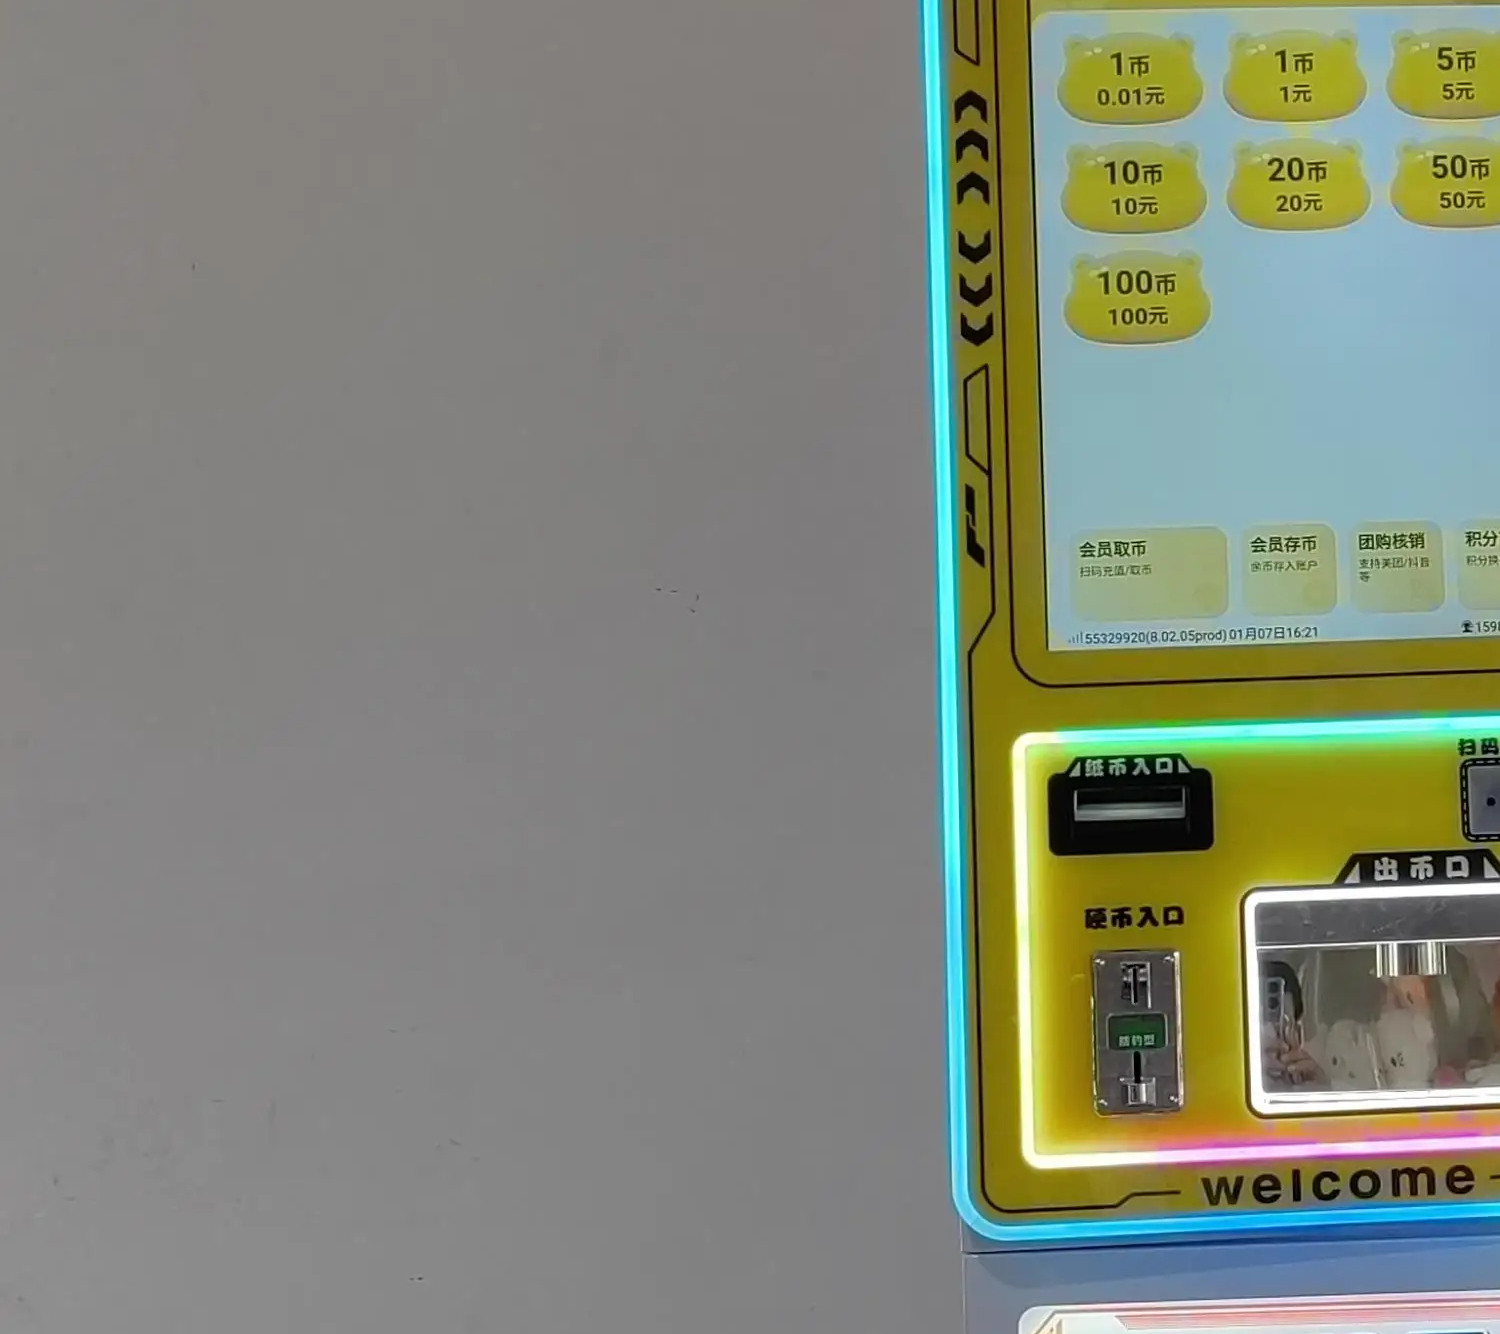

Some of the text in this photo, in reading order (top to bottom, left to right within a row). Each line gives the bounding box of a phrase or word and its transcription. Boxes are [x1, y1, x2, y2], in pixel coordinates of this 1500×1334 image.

[1109, 50, 1151, 79] 1币
[1274, 48, 1314, 76] 1币
[1436, 46, 1477, 74] 5币
[1096, 86, 1165, 108] 0.01元
[1279, 84, 1313, 105] 1元
[1441, 82, 1476, 102] 5元
[1103, 159, 1164, 187] 10币
[1267, 156, 1328, 185] 20币
[1431, 154, 1491, 182] 50币
[1111, 196, 1159, 217] 10元
[1275, 193, 1324, 214] 20元
[1438, 190, 1486, 211] 50元
[1096, 270, 1177, 298] 100币
[1107, 306, 1169, 327] 100元
[1078, 540, 1147, 559] 会员取币
[1250, 535, 1318, 554] 会员存币
[1358, 532, 1426, 551] 团购核销
[1229, 626, 1319, 641] 01月07日16:21
[1085, 757, 1174, 778] 纸币入口
[1374, 855, 1470, 882] 出币口
[1084, 906, 1185, 929] 硬币入口
[1202, 1163, 1475, 1207] welcome
